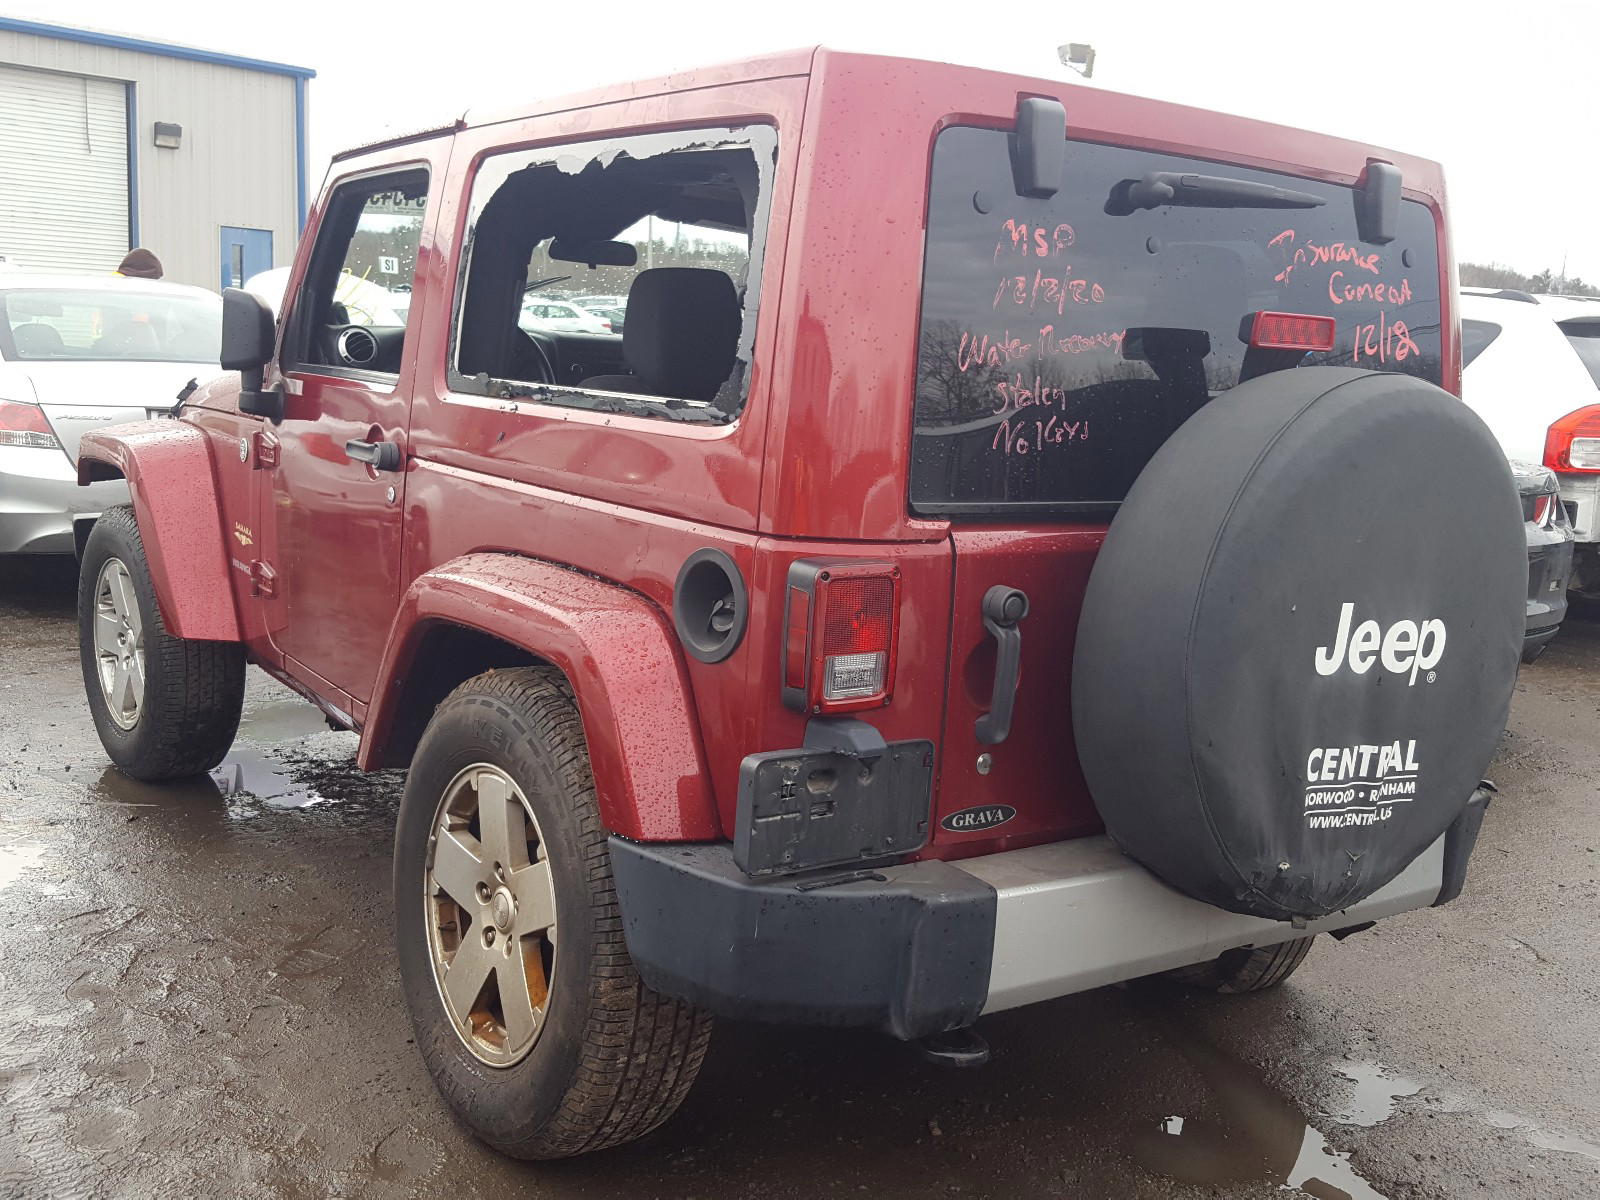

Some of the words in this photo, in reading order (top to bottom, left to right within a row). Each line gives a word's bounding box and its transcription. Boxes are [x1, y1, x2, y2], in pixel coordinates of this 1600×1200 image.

[992, 419, 1030, 456] No
[1315, 602, 1447, 686] Jeep
[1307, 740, 1420, 782] CENTRAL
[951, 808, 1005, 828] GRAVA
